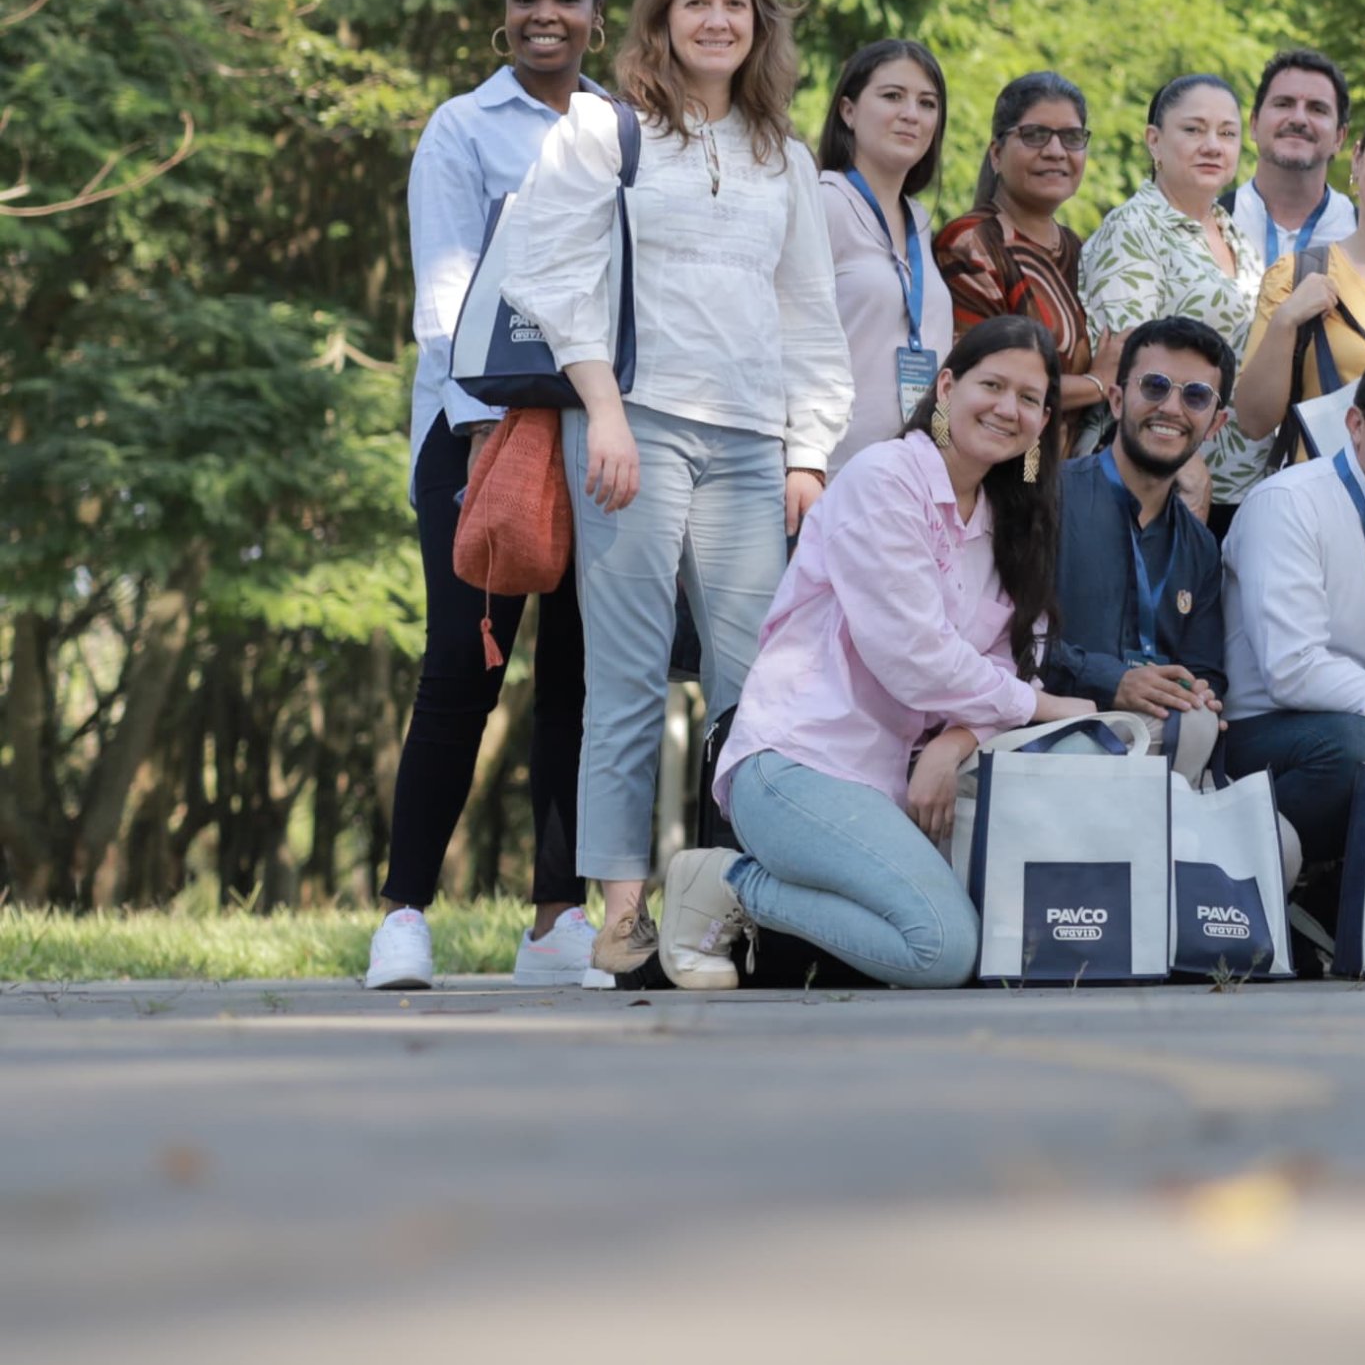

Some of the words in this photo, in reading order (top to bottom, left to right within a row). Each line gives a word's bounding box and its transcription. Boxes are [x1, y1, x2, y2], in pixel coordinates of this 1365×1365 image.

[1046, 907, 1108, 924] PAVCO
[1056, 926, 1099, 939] wavin
[1206, 924, 1247, 938] wavin
